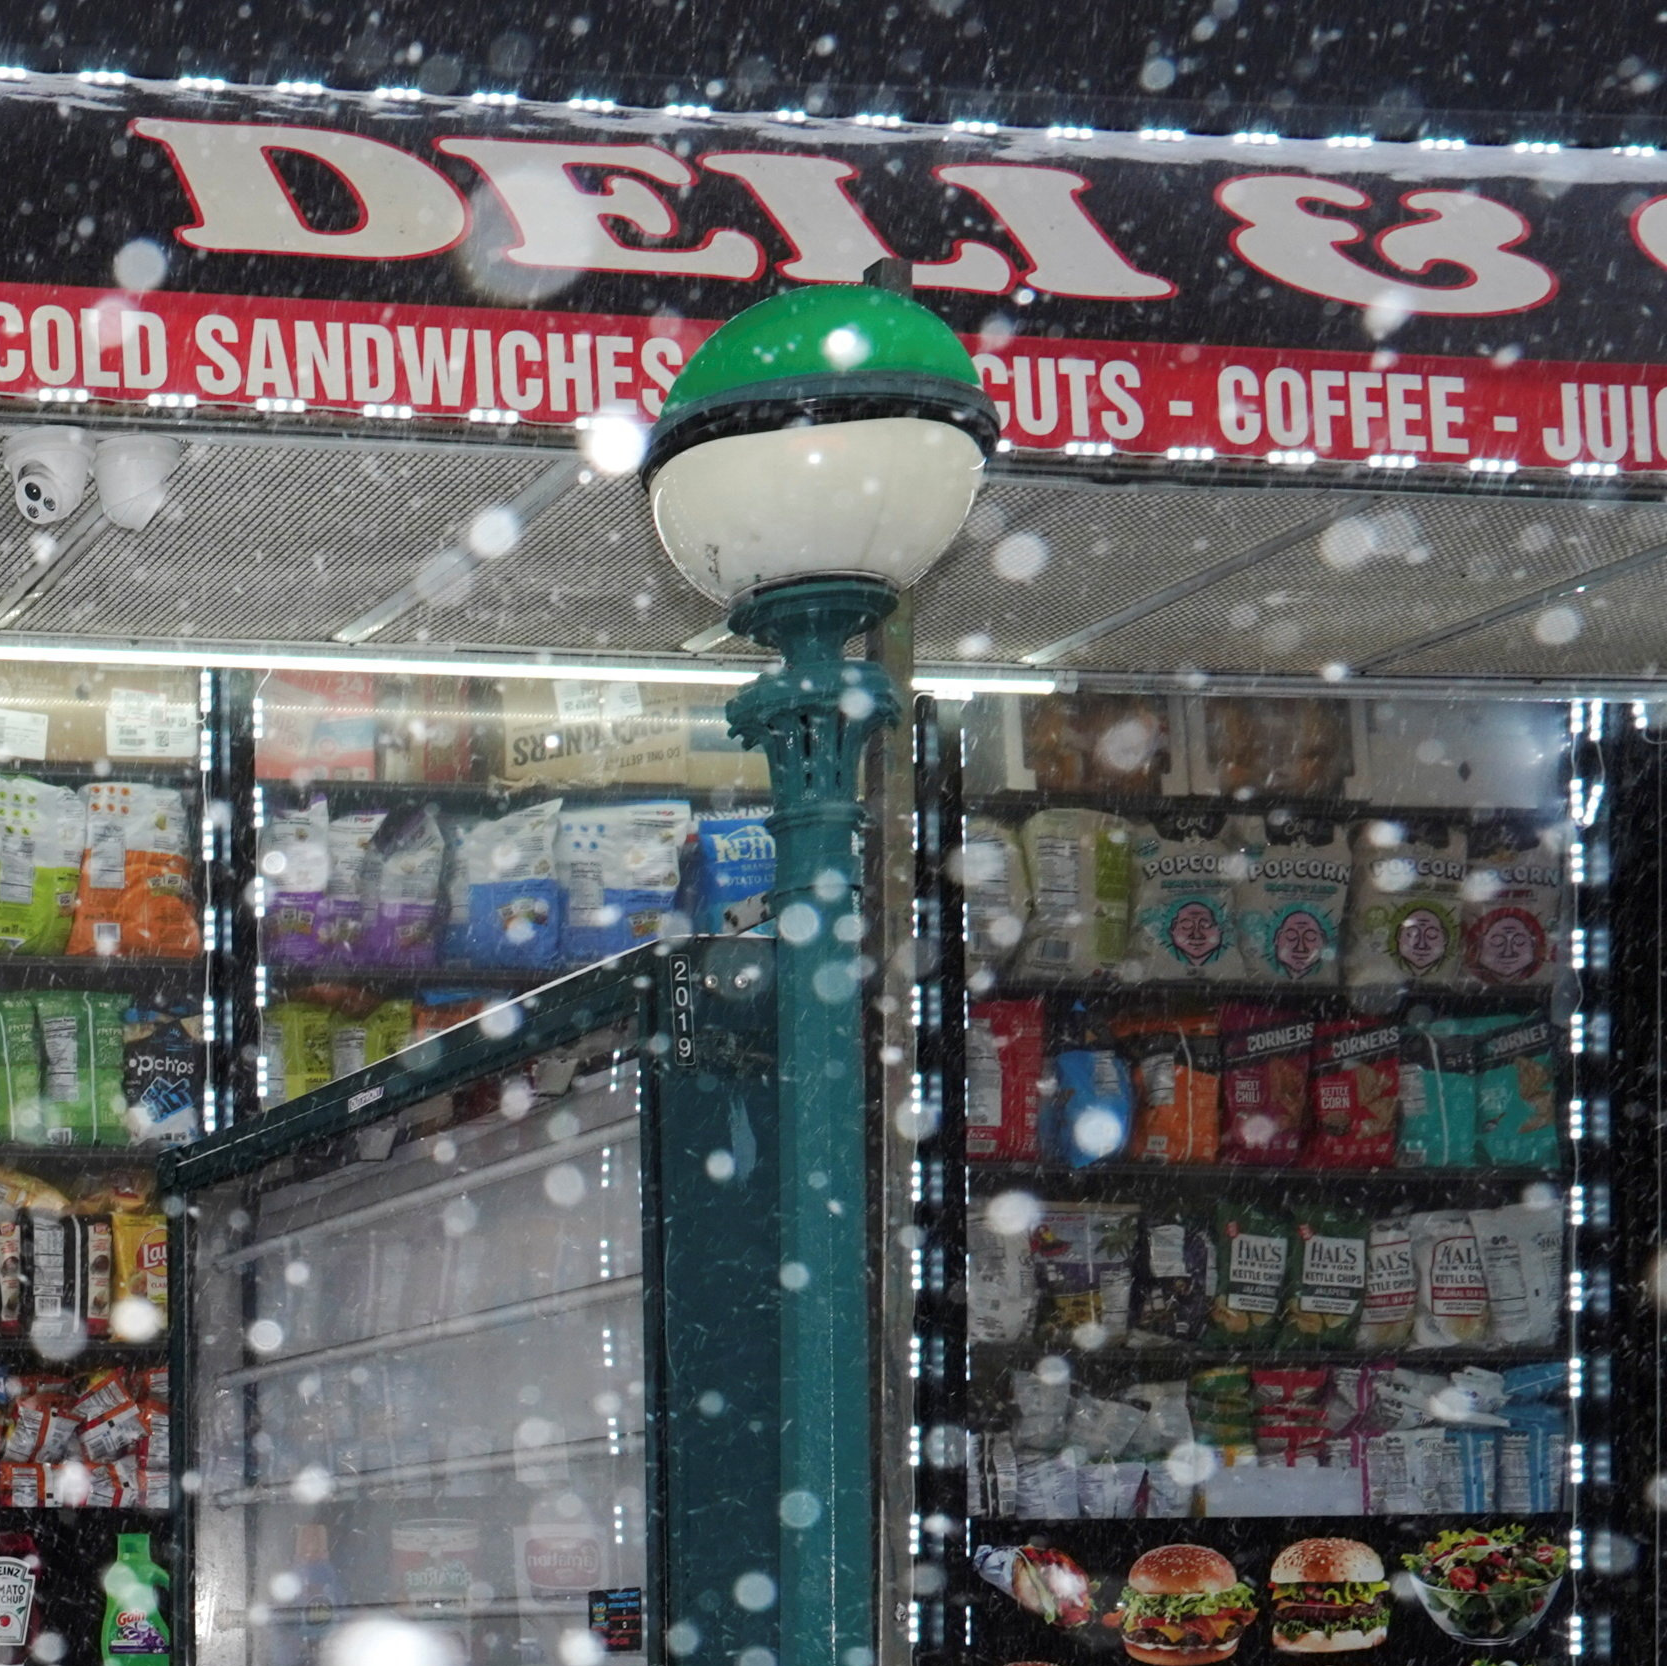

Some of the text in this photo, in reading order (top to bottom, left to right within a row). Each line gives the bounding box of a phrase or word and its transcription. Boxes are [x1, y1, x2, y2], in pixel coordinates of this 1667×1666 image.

[128, 115, 1179, 300] DELI
[1213, 173, 1560, 318] &
[195, 315, 680, 420] SANDWICHES
[1217, 365, 1469, 454] COFFEE
[672, 961, 692, 1058] 2019
[1246, 1021, 1315, 1053] CORNERS
[1332, 1025, 1400, 1059] CORNERS
[1320, 1086, 1350, 1098] KETTLE
[1321, 1096, 1351, 1110] CORN
[1238, 1239, 1282, 1264] HAL'S
[1310, 1239, 1357, 1266] HAL'S
[1232, 1269, 1261, 1281] KETTLE
[1304, 1270, 1363, 1285] KETTLE CHIPS
[1331, 1263, 1356, 1272] YORK
[1434, 1273, 1465, 1285] KETTLE
[116, 1610, 146, 1626] Gain
